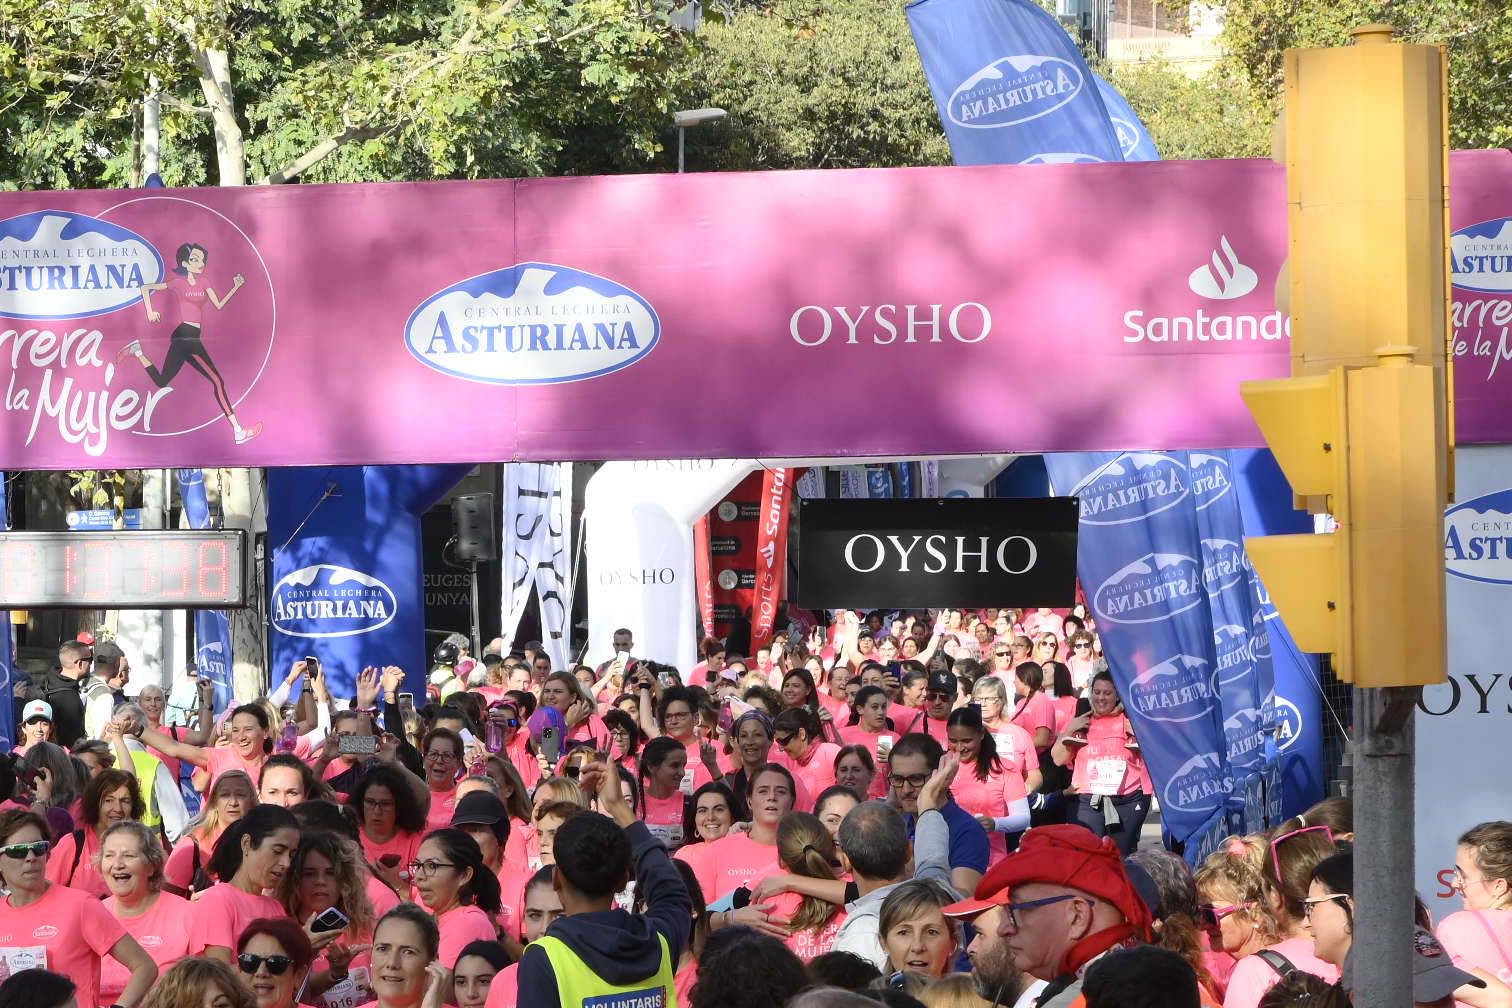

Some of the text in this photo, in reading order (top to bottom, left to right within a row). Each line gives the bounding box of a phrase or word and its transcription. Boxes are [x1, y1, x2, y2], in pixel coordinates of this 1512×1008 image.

[66, 246, 139, 259] LECHERA
[464, 303, 631, 319] CENTRAL LECHERA
[790, 302, 993, 346] OYSHO
[425, 310, 641, 355] ASTURIANA
[1123, 309, 1291, 344] Santand
[5, 369, 31, 411] la
[24, 362, 175, 457] Mujer
[1472, 521, 1512, 532] CENT
[844, 533, 1038, 575] OYSHO
[599, 567, 675, 584] OYSHO
[275, 593, 388, 621] ASTURIANA
[288, 588, 383, 599] CENTRAL LECHERA
[798, 935, 814, 946] DE
